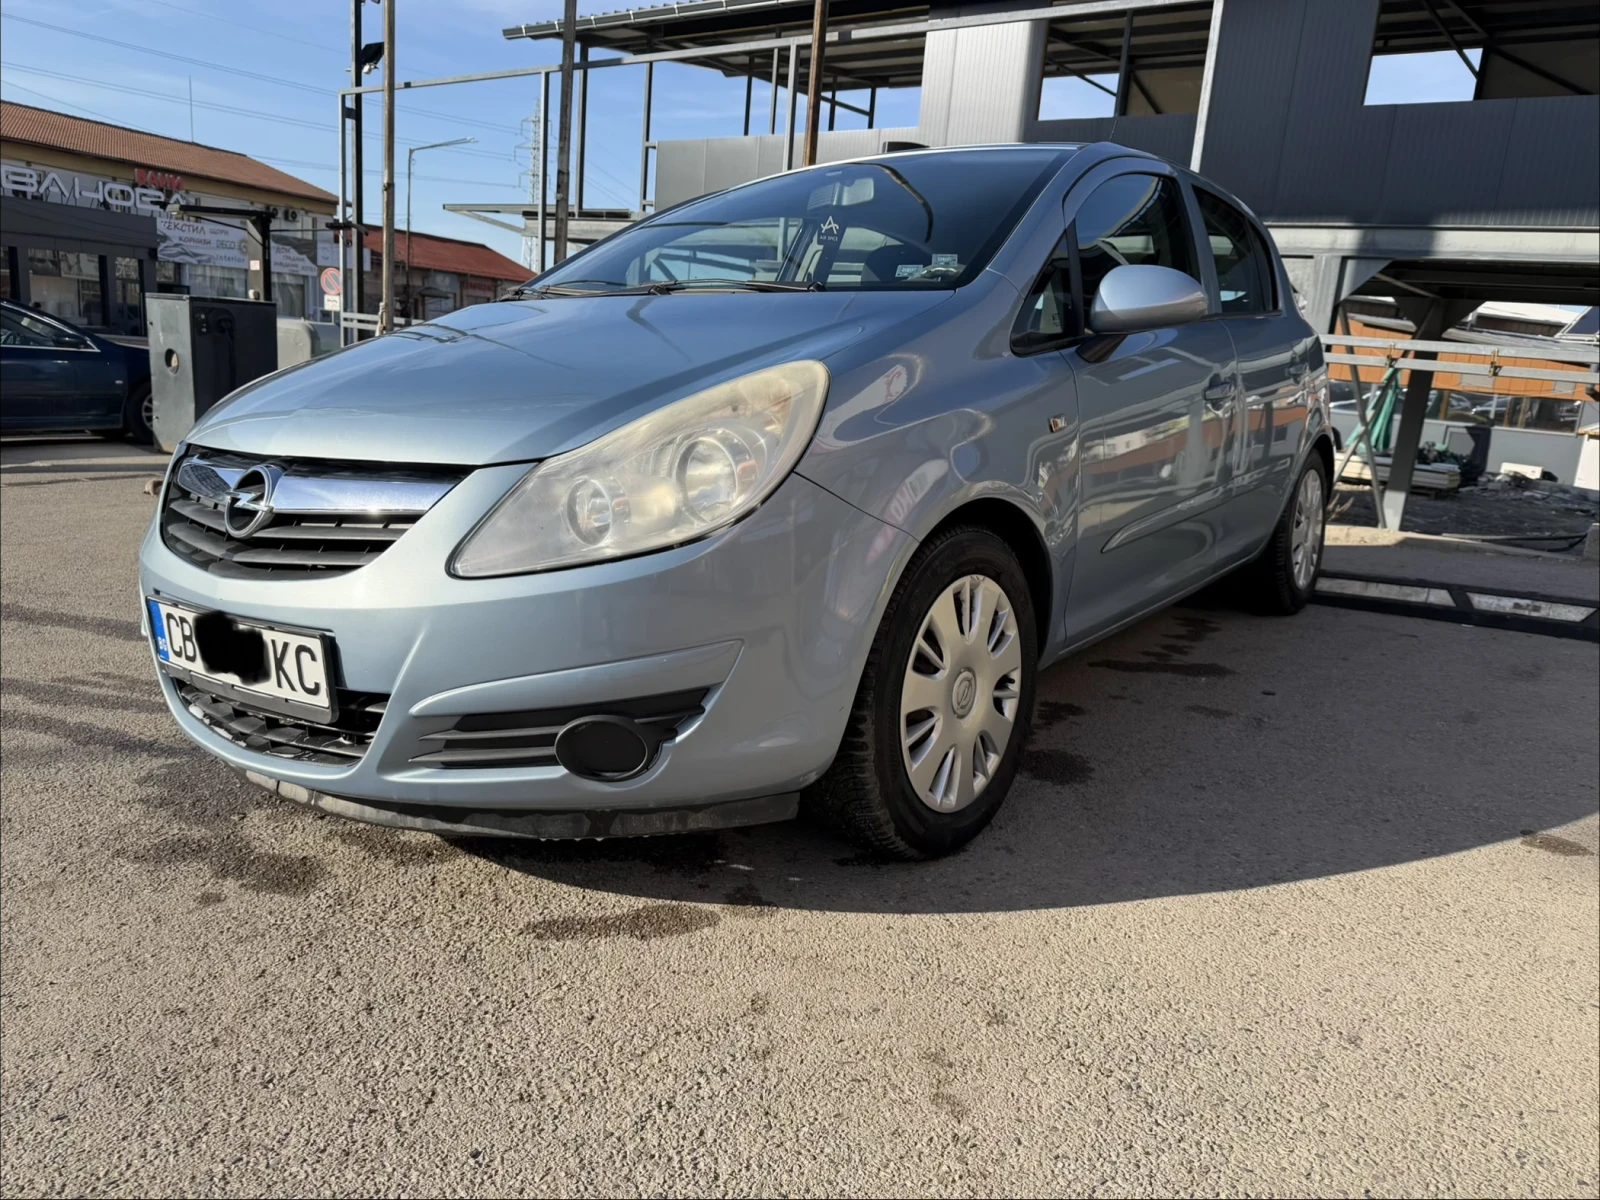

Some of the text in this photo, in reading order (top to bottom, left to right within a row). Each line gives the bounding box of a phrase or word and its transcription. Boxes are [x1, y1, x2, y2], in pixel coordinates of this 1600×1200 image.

[161, 219, 206, 235] ТЕКСТИЛ
[165, 612, 321, 696] CB KC
